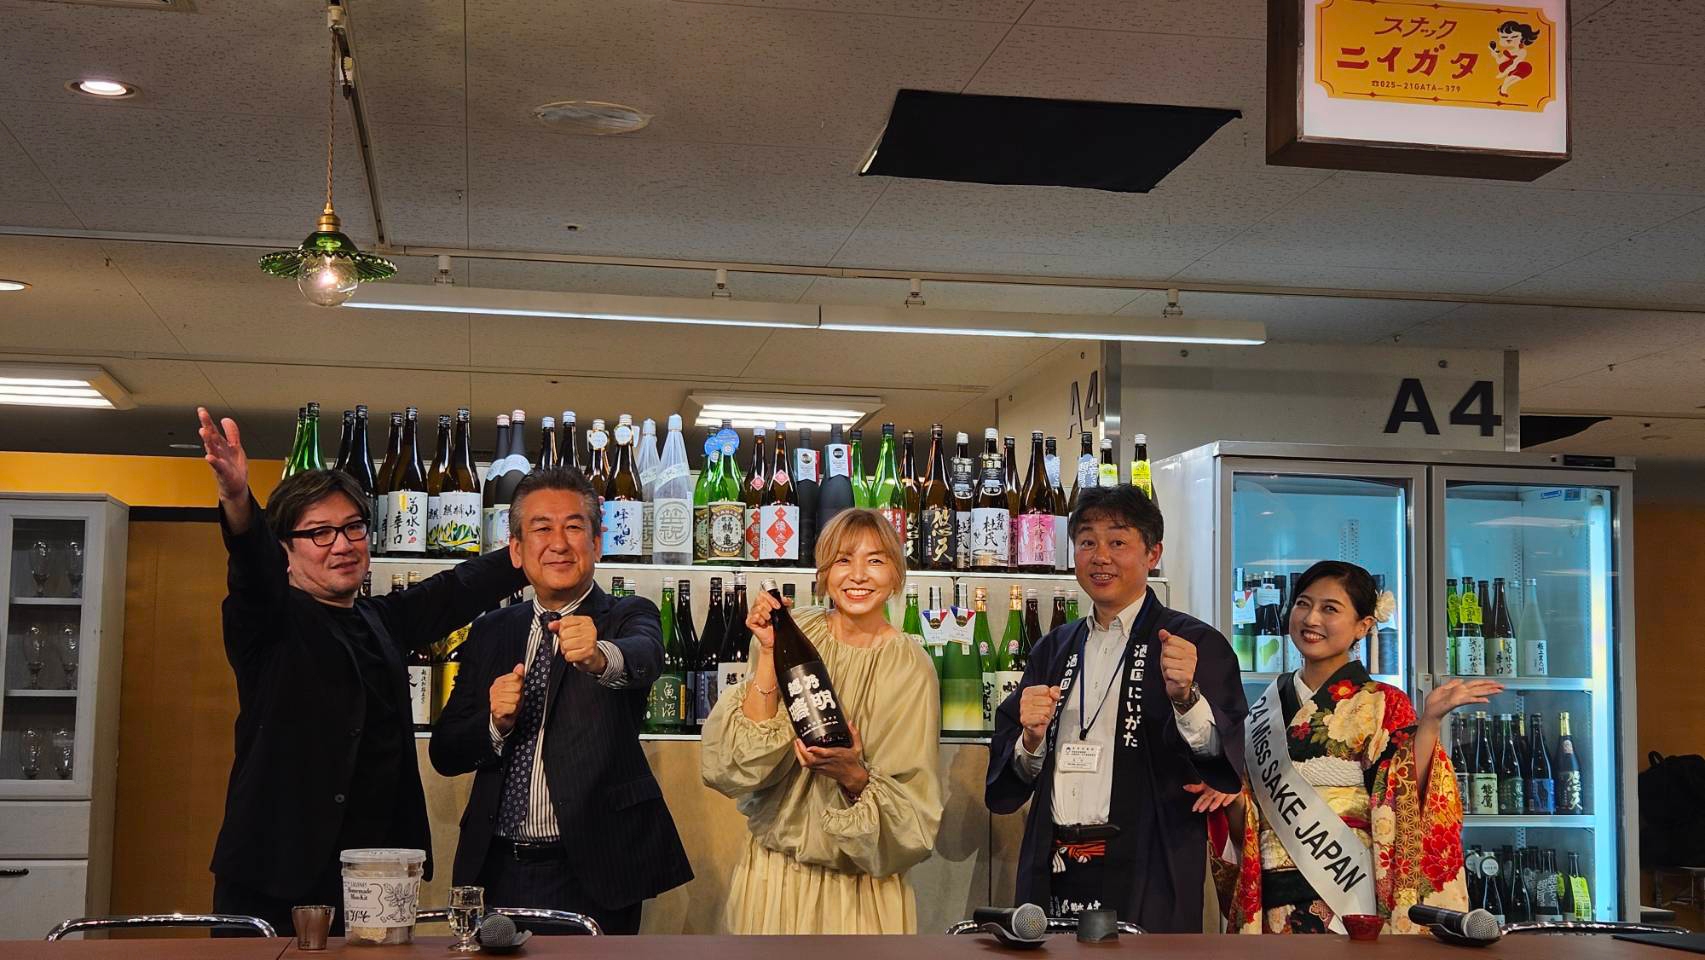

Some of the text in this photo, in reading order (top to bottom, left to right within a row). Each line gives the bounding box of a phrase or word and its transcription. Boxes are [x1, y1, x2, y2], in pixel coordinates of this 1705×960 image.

[1374, 16, 1458, 40] スナック
[1336, 43, 1479, 80] ニイガタ
[1383, 377, 1502, 437] A4
[1123, 644, 1149, 748] 酒の国 にいがた
[1251, 718, 1272, 766] Miss
[1261, 761, 1307, 826] SAKE
[1294, 820, 1368, 894] JAPAN
